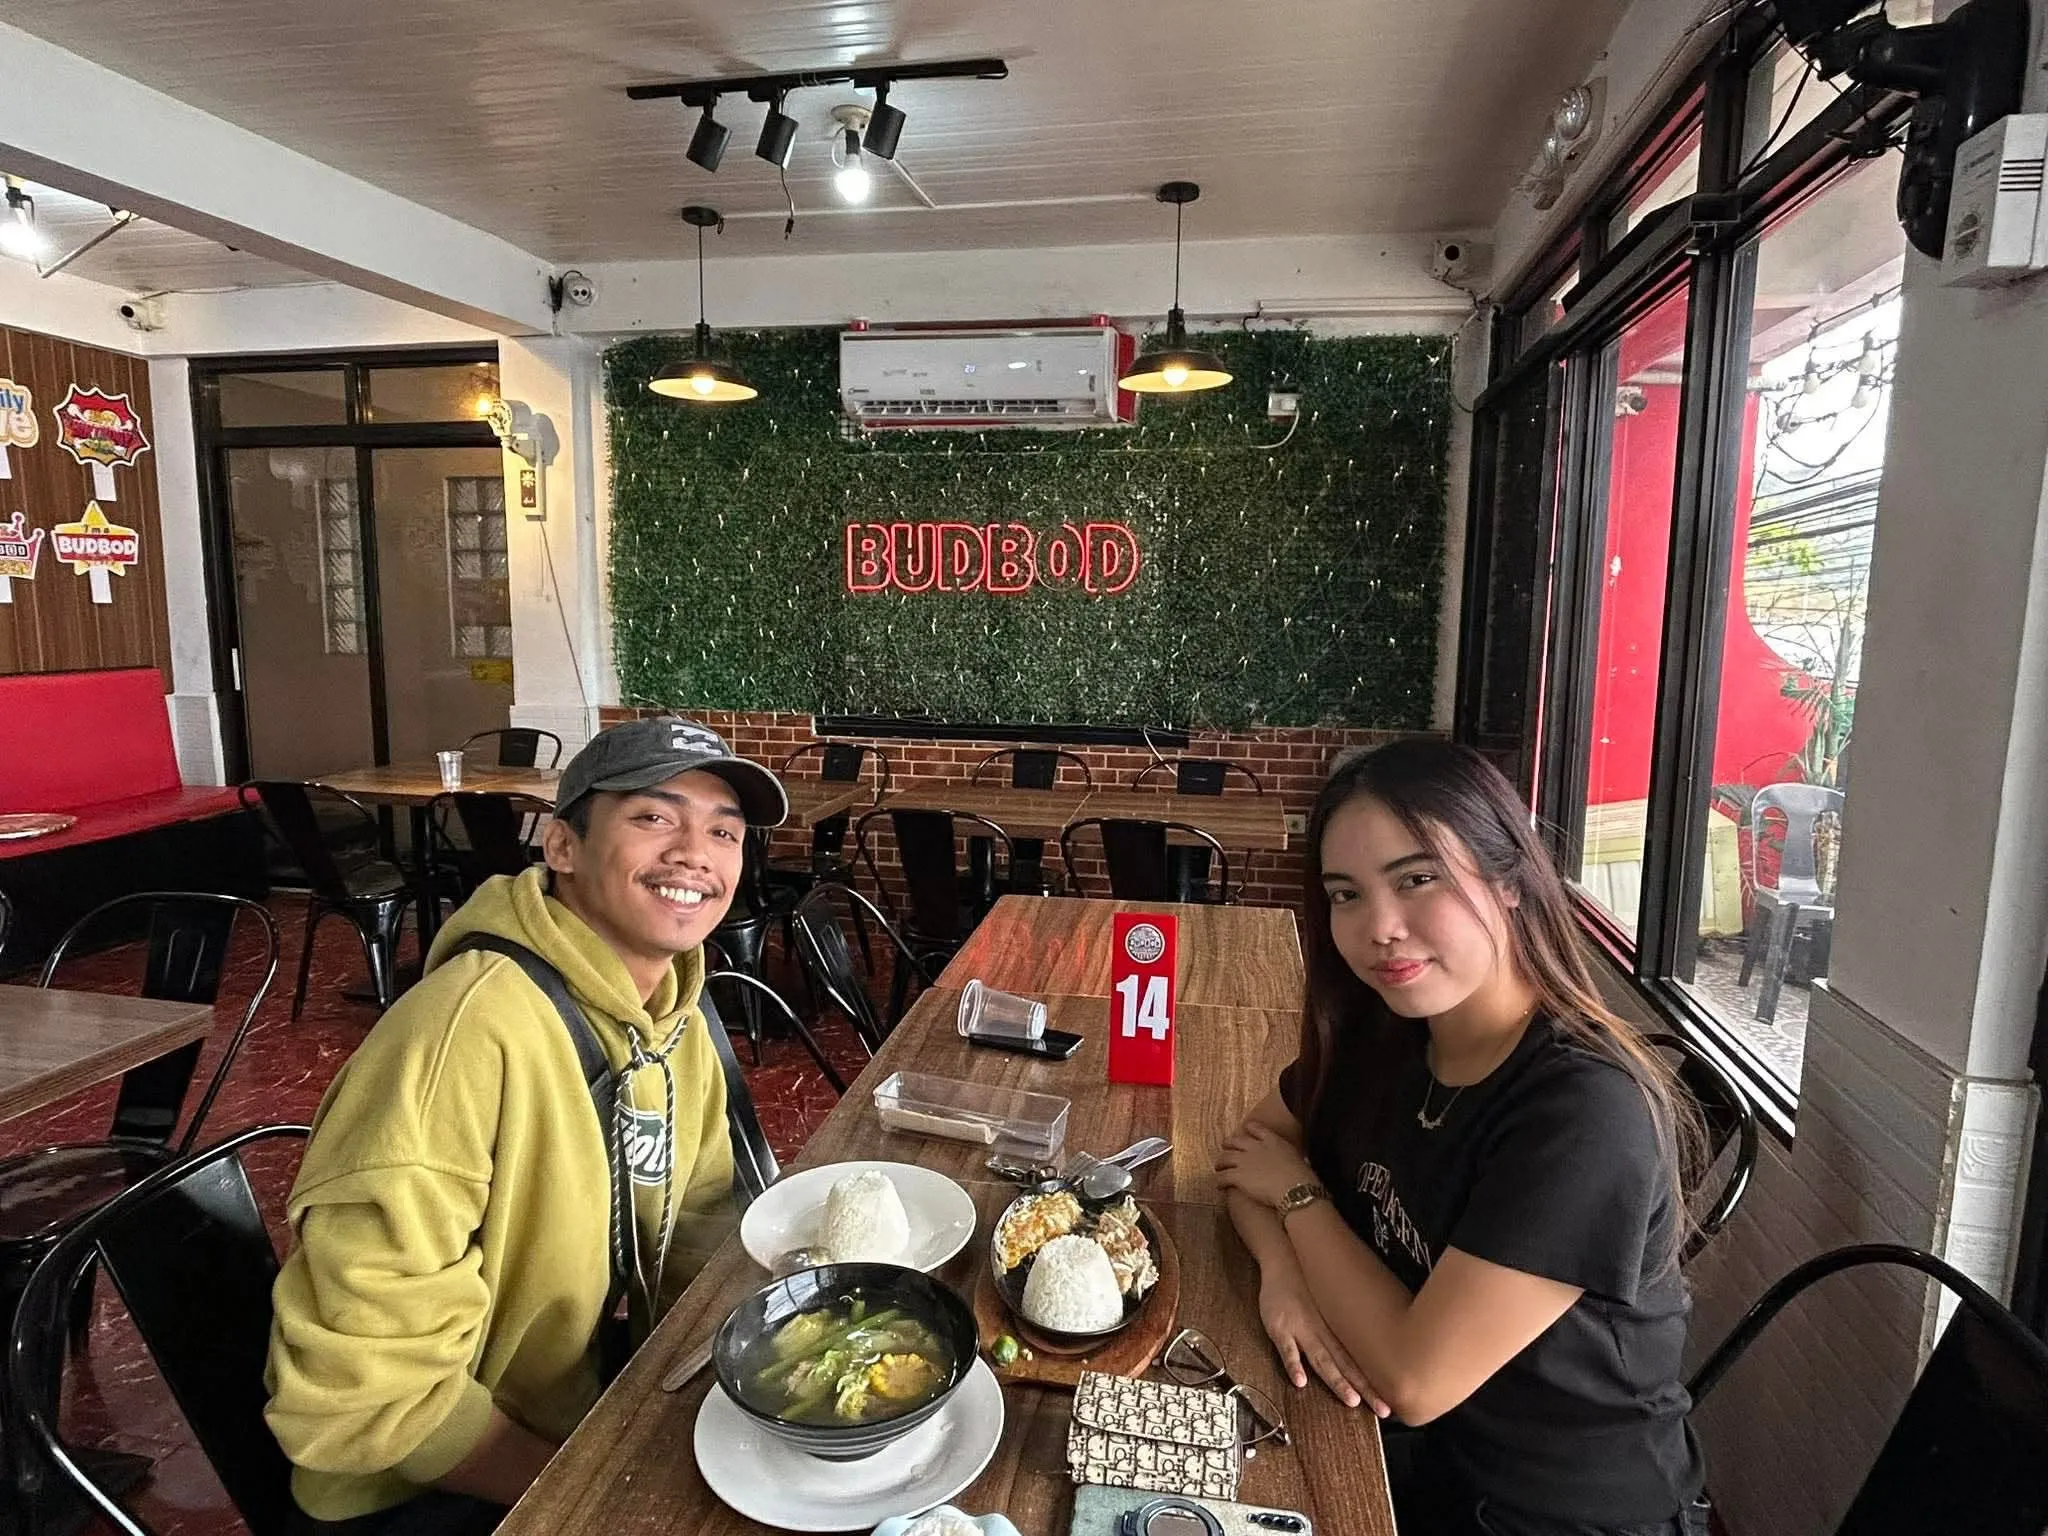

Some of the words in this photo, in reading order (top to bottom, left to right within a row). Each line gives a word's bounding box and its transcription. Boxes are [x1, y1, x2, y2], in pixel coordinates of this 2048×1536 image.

[58, 535, 135, 555] BUDBOD
[847, 523, 1139, 592] BUDBOD
[1116, 974, 1170, 1040] 14
